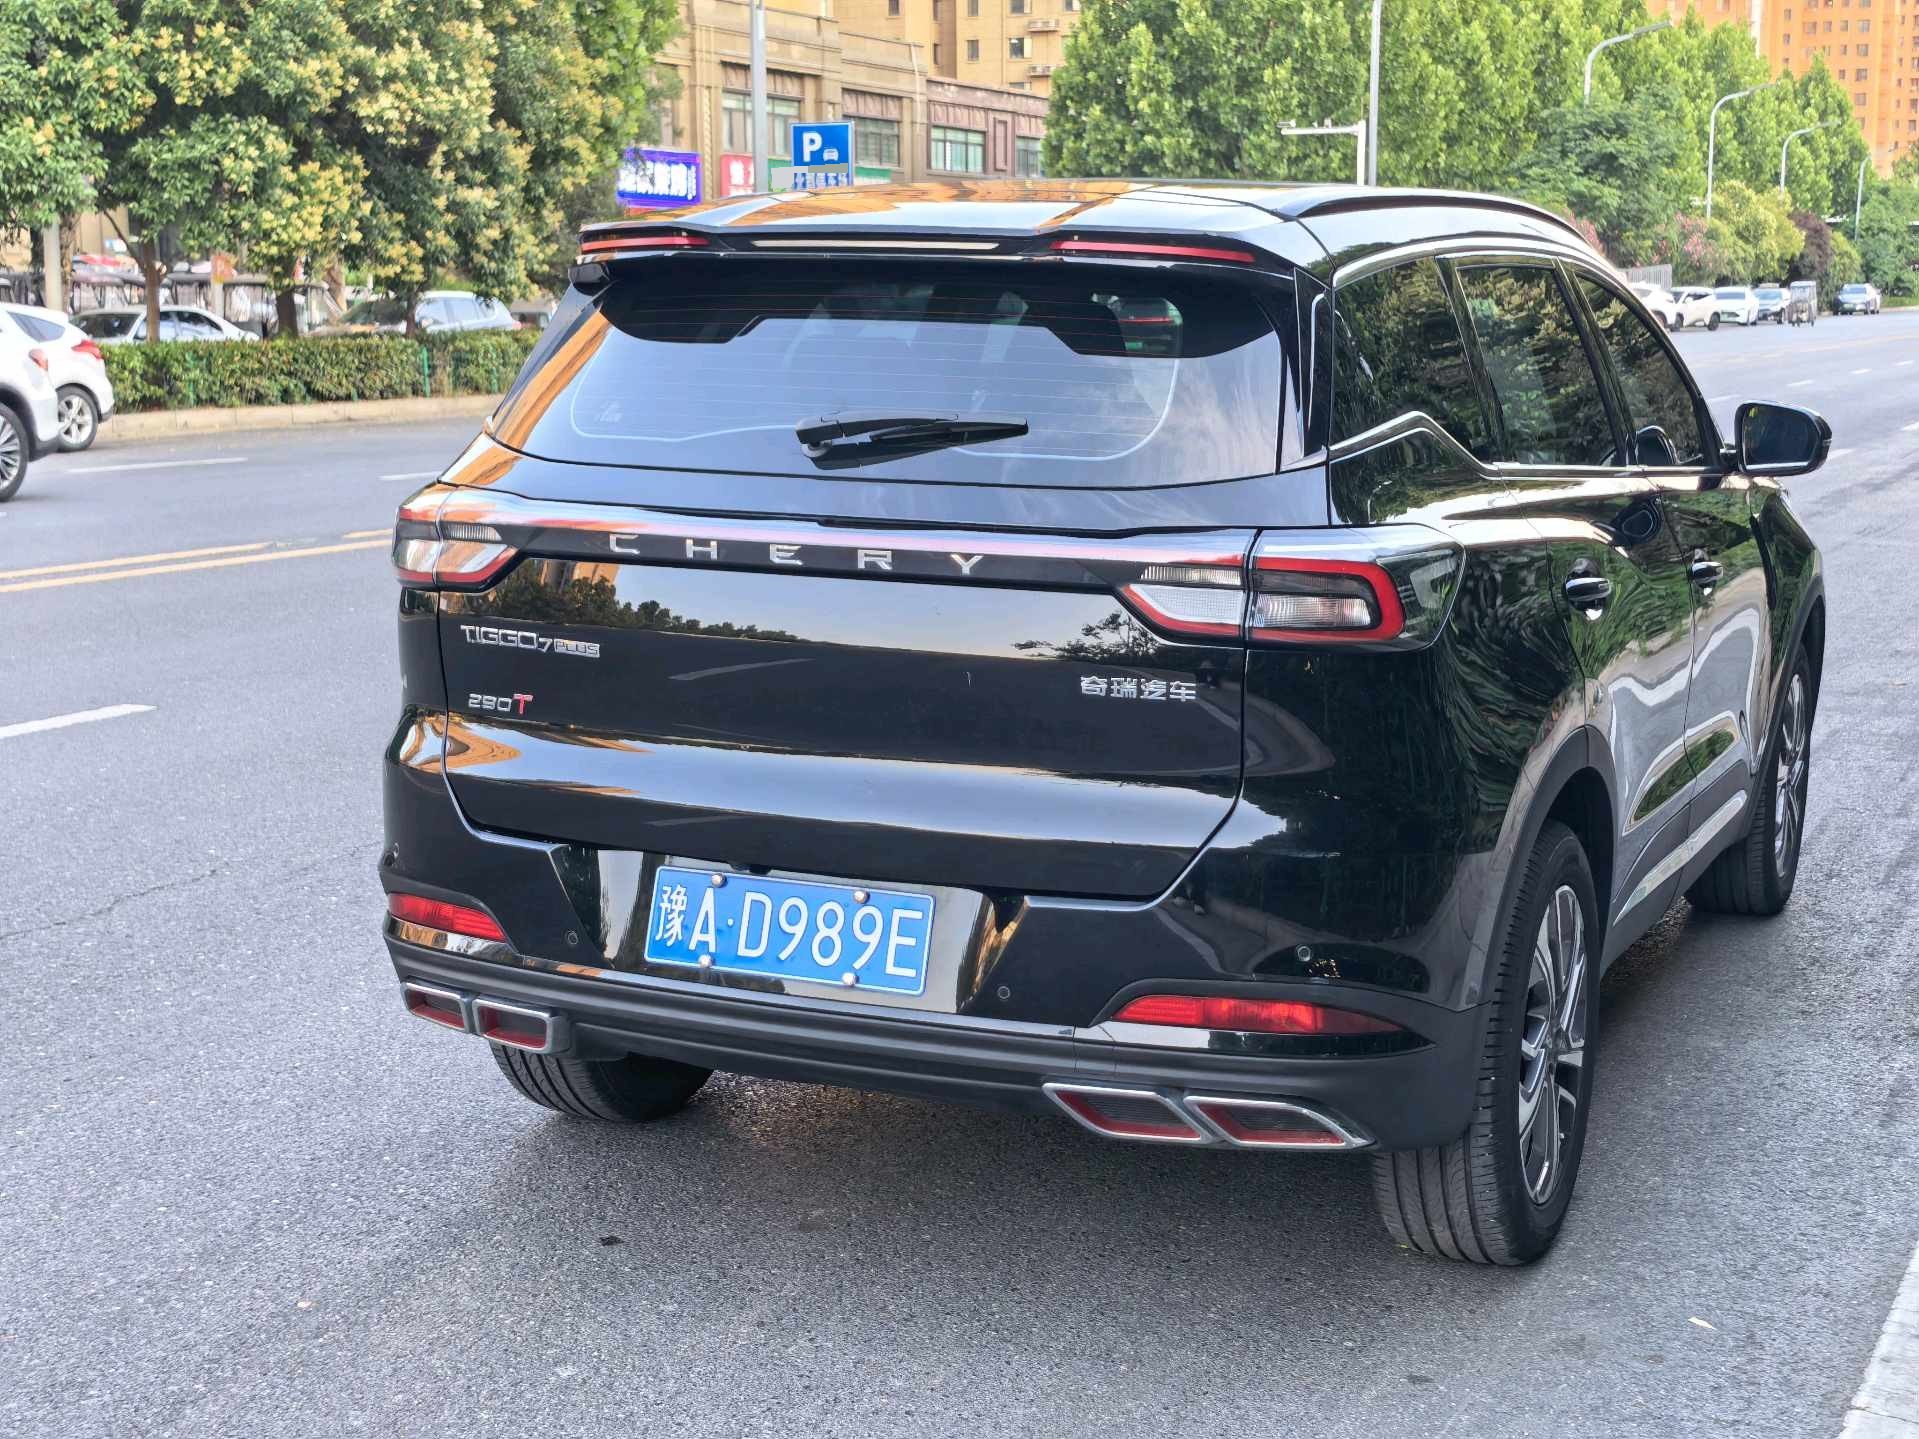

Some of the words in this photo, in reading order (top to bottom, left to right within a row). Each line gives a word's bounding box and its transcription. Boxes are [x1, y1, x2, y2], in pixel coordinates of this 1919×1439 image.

[802, 131, 822, 162] P
[608, 532, 983, 576] CHERY
[1080, 675, 1197, 702] 奇瑞汽车
[468, 693, 534, 715] 290T
